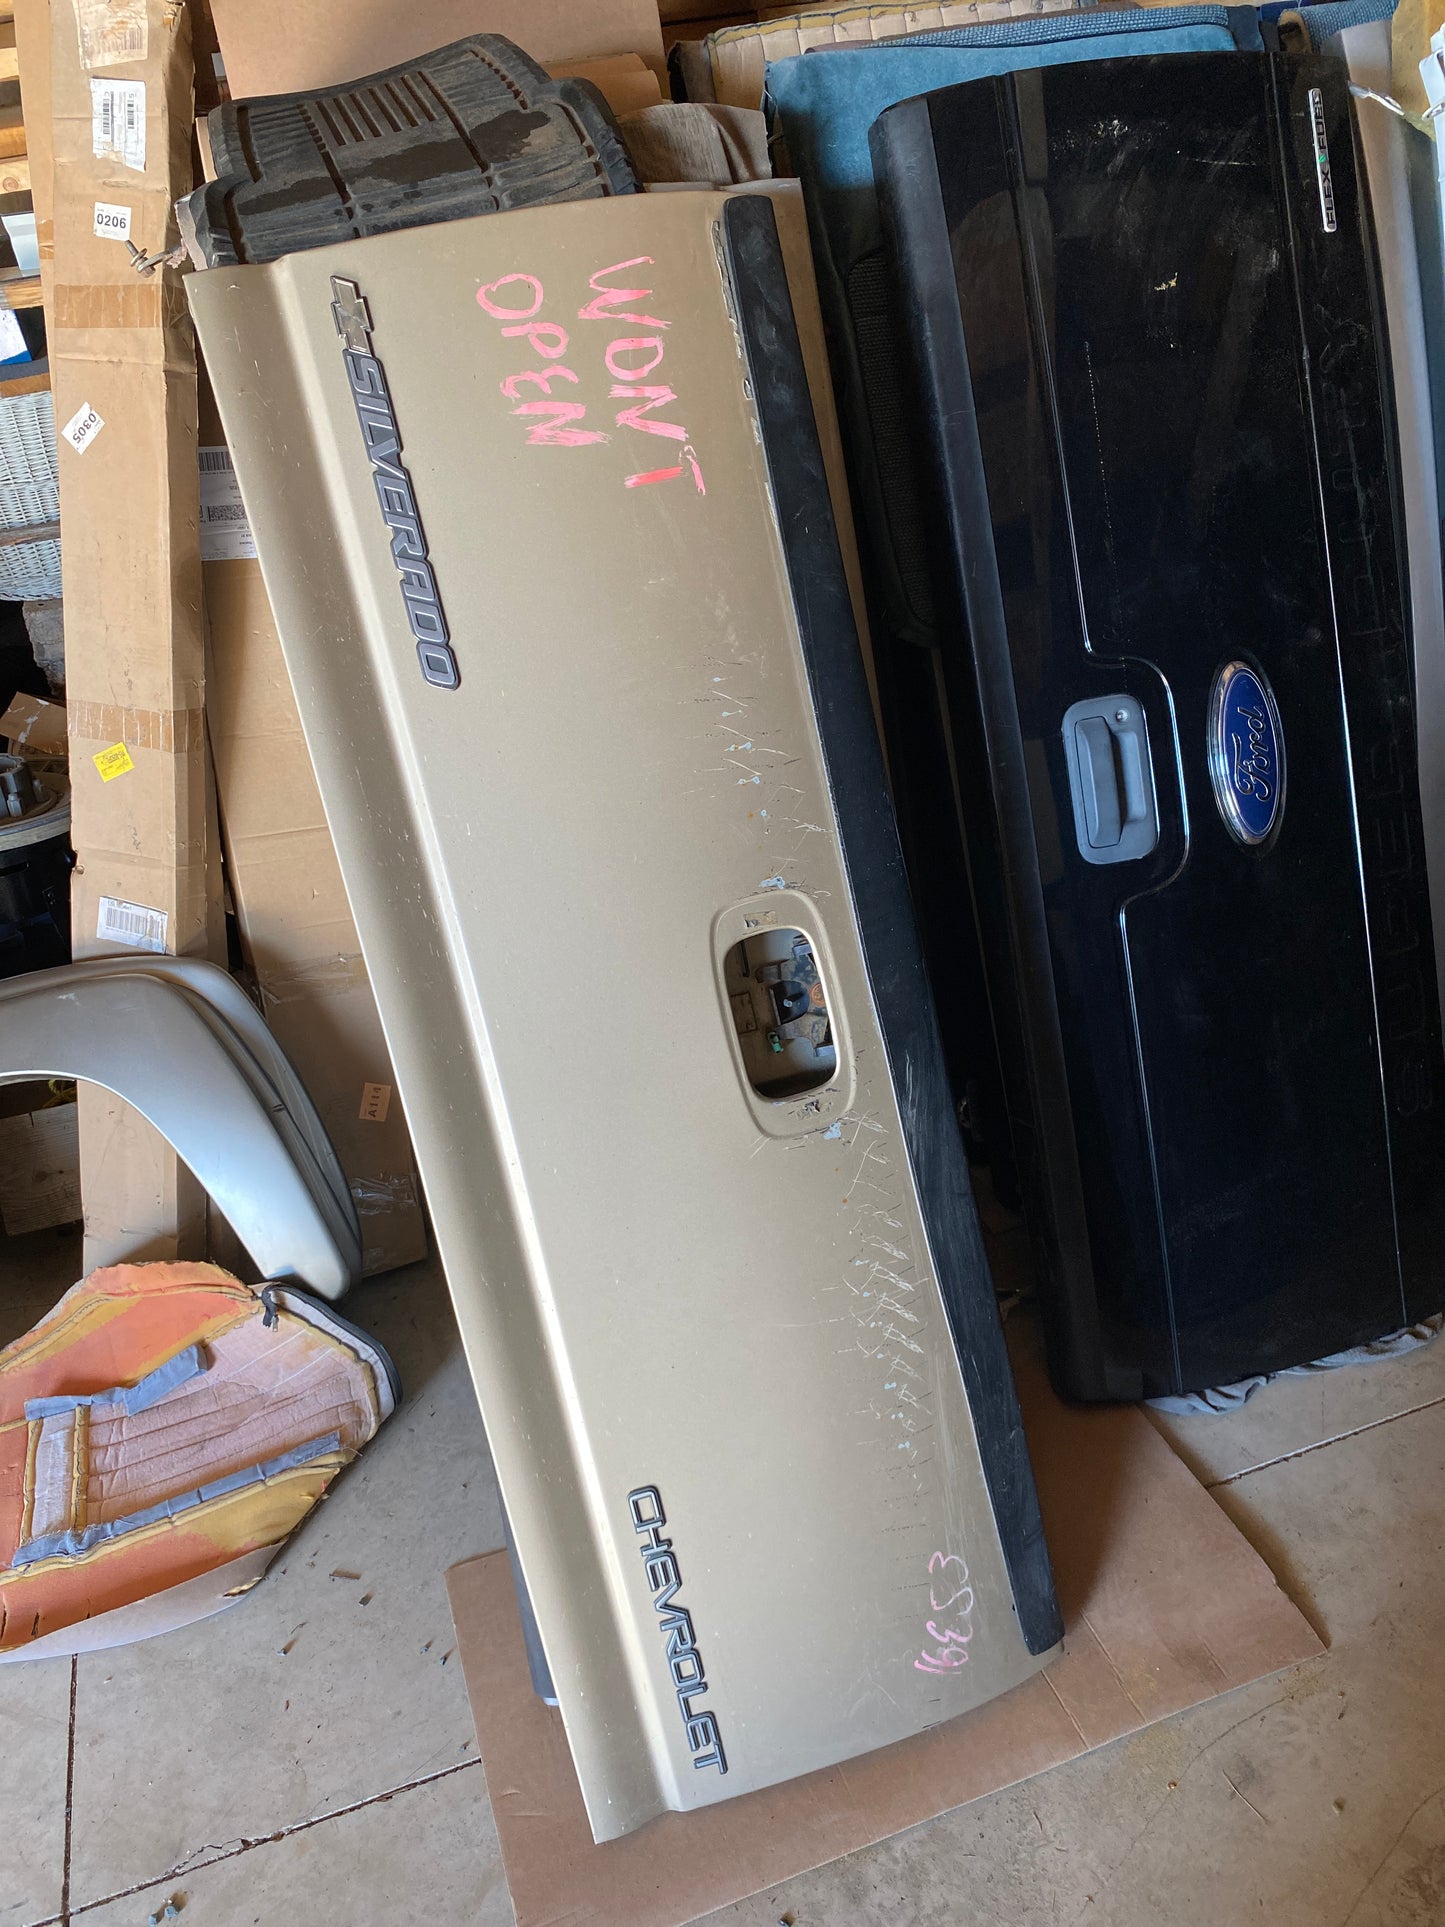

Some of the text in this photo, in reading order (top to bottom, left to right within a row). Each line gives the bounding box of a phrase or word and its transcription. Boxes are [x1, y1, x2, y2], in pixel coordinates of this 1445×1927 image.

[96, 213, 127, 229] 0206
[1321, 169, 1335, 225] FLEX
[476, 273, 611, 446] OPEN
[72, 413, 97, 444] 0305
[345, 349, 460, 690] SILVERADO
[1231, 705, 1272, 803] Ford
[627, 1485, 729, 1775] CHEVROLET
